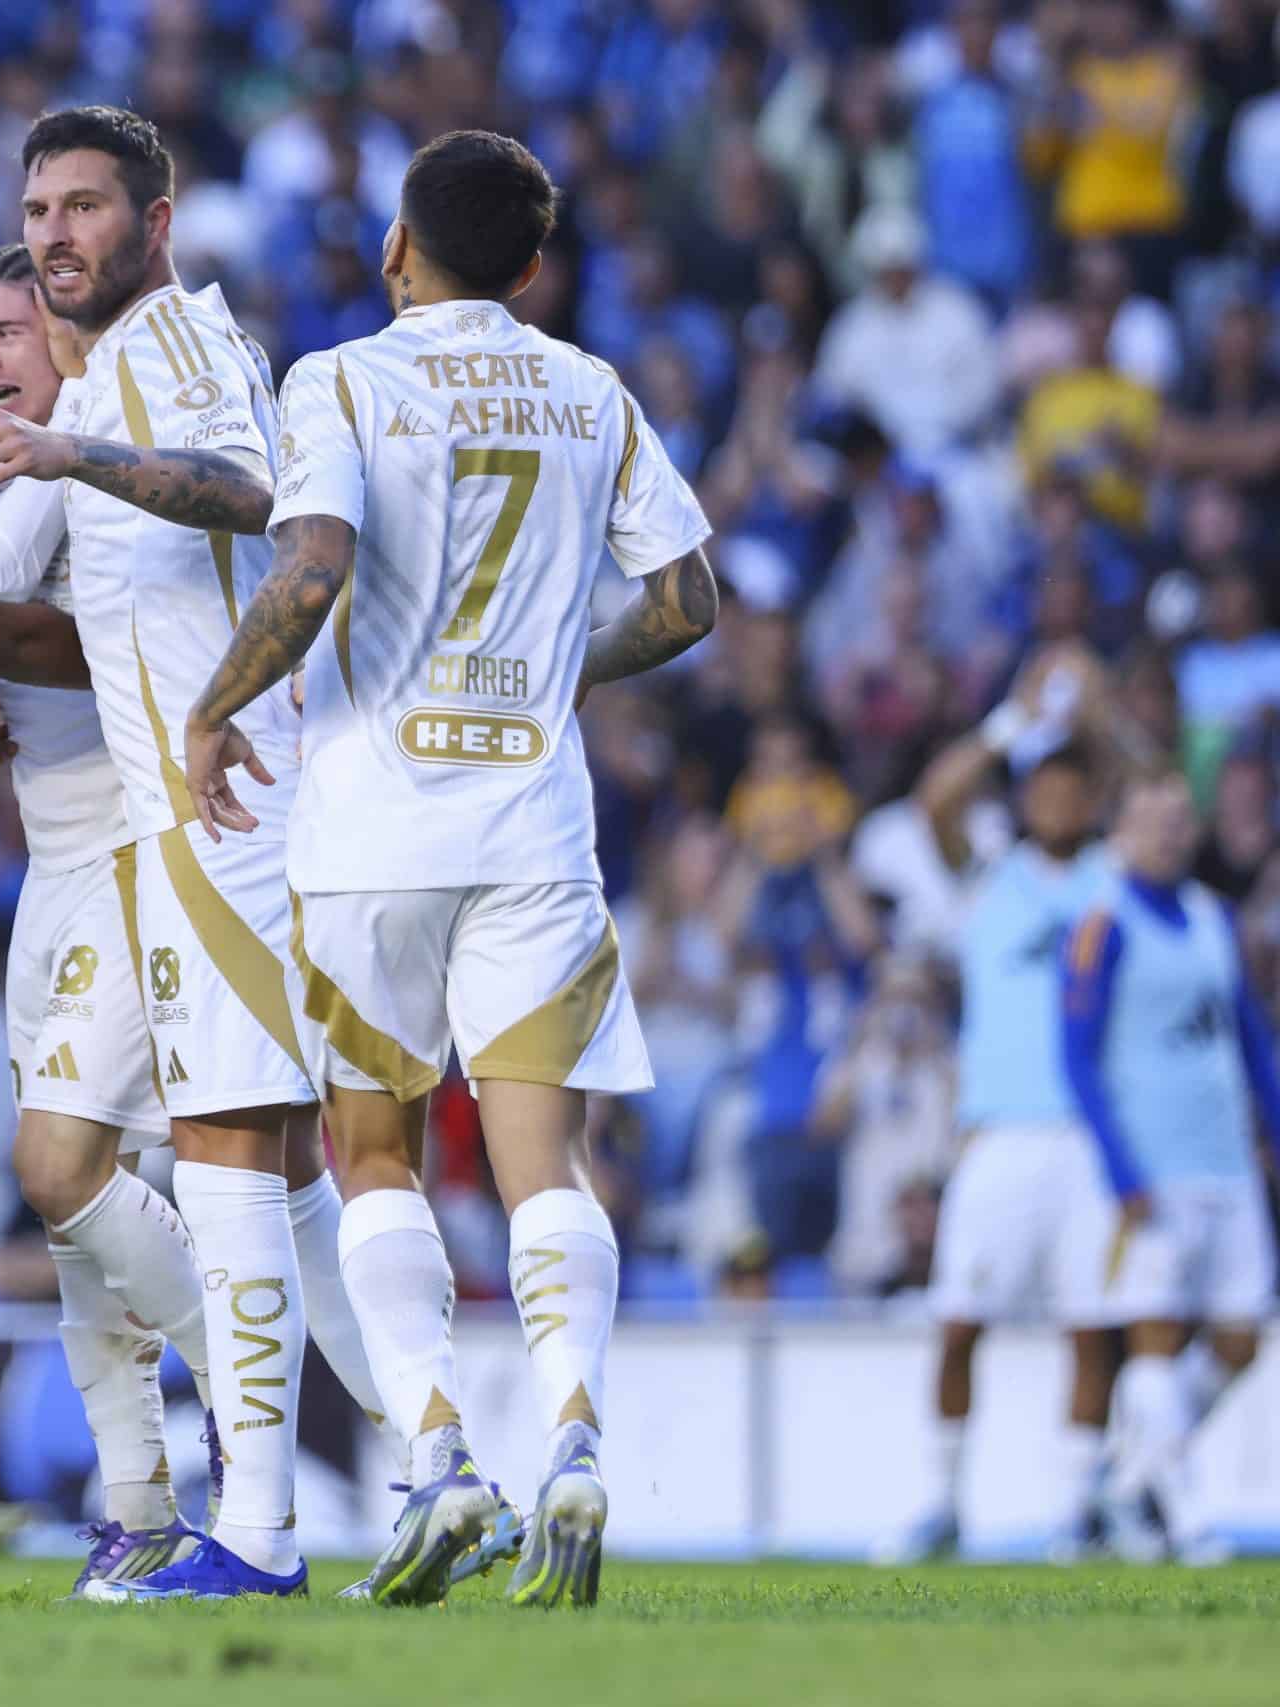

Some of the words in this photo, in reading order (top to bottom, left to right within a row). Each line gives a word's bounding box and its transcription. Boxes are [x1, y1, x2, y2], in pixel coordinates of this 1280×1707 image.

[414, 352, 549, 388] TECATE
[447, 398, 597, 440] AFIRME
[440, 448, 541, 640] 7
[429, 654, 528, 698] CORREA
[416, 720, 531, 755] H-E-B
